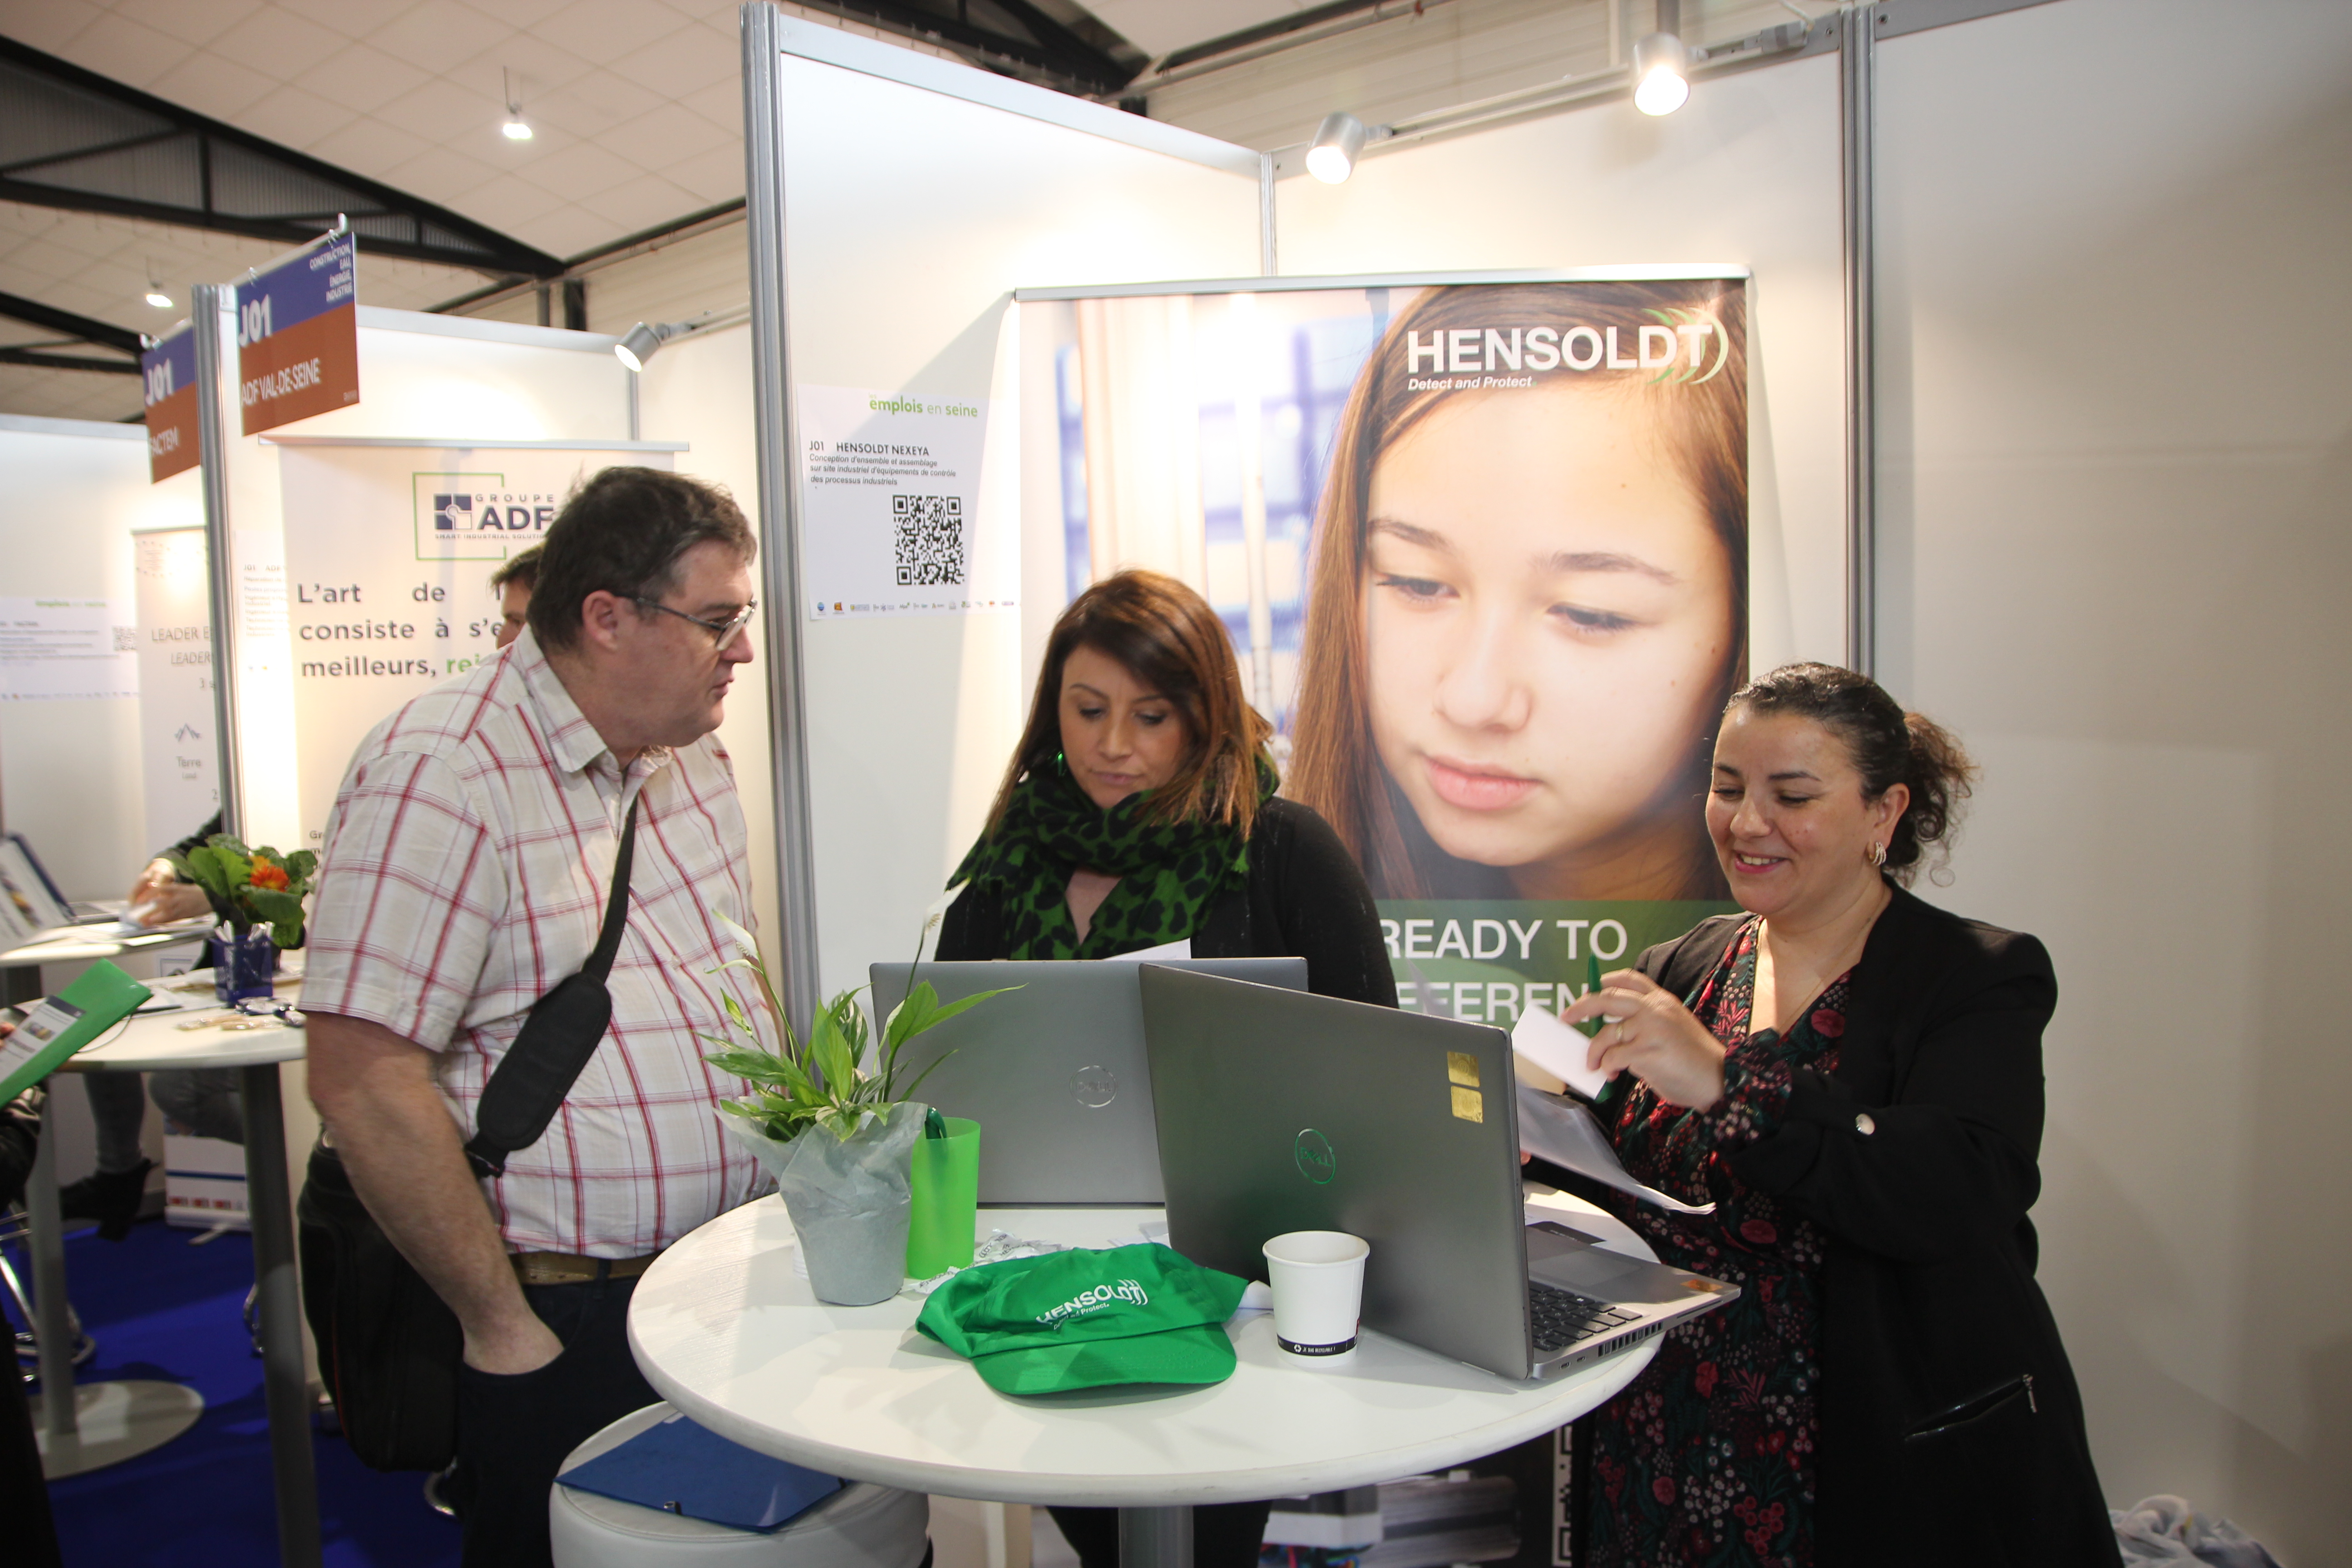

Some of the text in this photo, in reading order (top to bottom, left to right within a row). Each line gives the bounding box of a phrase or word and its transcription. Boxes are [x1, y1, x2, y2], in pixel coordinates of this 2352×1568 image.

[310, 242, 351, 270] CONSTRUCTION,
[326, 282, 352, 302] INDUSTRIE
[238, 294, 271, 347] J01
[1408, 324, 1713, 372] HENSOLDT
[145, 358, 173, 406] J01
[242, 357, 320, 405] ADF VAL-DE-SEINE
[1408, 378, 1452, 391] Detect
[1455, 377, 1481, 390] and
[869, 395, 978, 417] emplois en seine
[809, 441, 929, 456] J01 HENSOLDT NEXEYA
[809, 453, 848, 463] Conception
[851, 455, 889, 464] d'ensemble
[899, 458, 937, 468] assemblage
[837, 465, 869, 473] industriel
[871, 466, 919, 475] d'équipements
[862, 476, 897, 485] industriels
[475, 494, 554, 502] GROUPE
[476, 505, 554, 530] ADF
[297, 582, 361, 603] L'art
[412, 581, 446, 602] de
[152, 627, 198, 641] LEADER
[299, 618, 415, 640] consiste
[435, 617, 449, 637] à
[171, 651, 211, 664] LEADER
[301, 655, 436, 678] meilleurs,
[176, 755, 201, 767] Terre
[1380, 919, 1628, 960] READY TO
[1036, 1284, 1142, 1325] HENSOLDT
